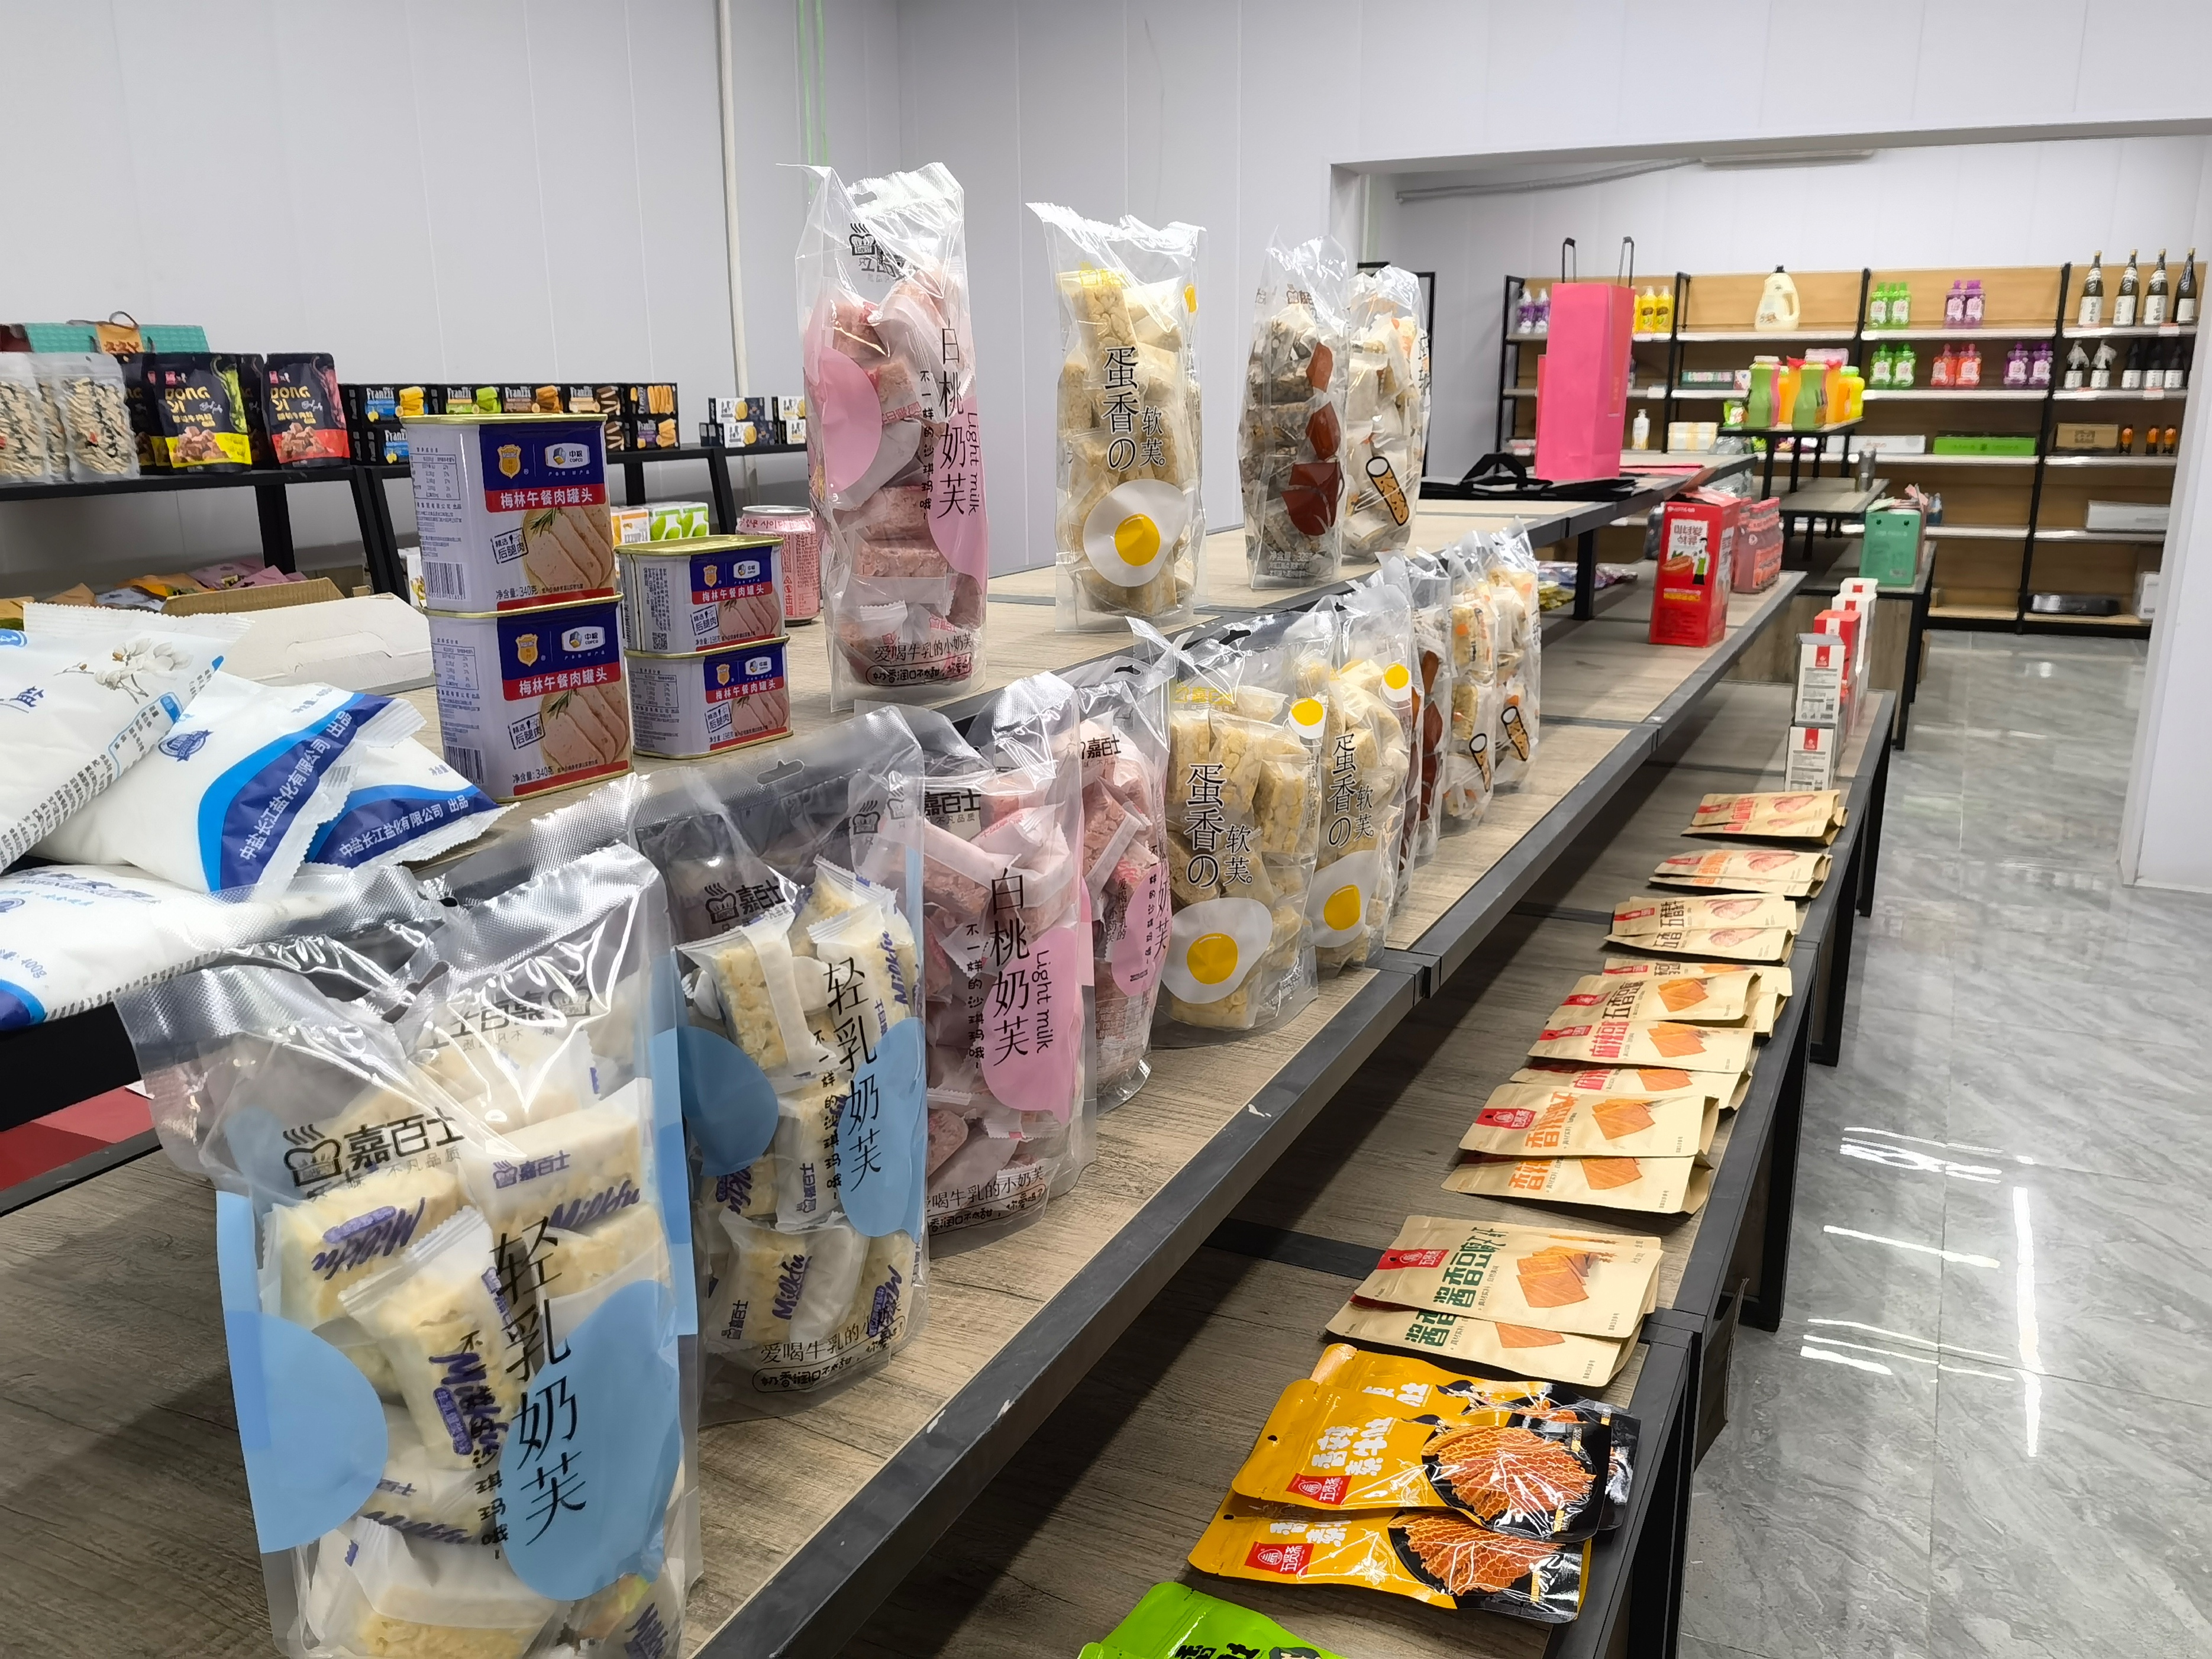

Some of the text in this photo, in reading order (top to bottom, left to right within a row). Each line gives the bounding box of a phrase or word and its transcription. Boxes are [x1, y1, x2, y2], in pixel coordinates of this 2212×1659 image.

[937, 318, 966, 519] 白桃奶芙
[966, 412, 980, 515] Light milk
[500, 488, 593, 509] 梅林午餐肉罐头
[702, 585, 764, 603] 梅林午餐肉罐头
[519, 667, 608, 697] 梅林午餐肉罐头
[715, 679, 776, 700] 梅林午餐肉罐头
[240, 737, 331, 861] 中盐长江盐化有限公司
[326, 710, 353, 738] 出品
[338, 795, 469, 858] 中盐长江盐化有限公司 出品
[1184, 762, 1228, 890] 蛋香の
[989, 867, 1031, 1066] 白桃奶芙
[1031, 950, 1055, 1054] Light milk
[823, 956, 883, 1192] 轻乳奶芙
[489, 1216, 587, 1546] 轻乳奶芙
[1319, 1477, 1342, 1502] 五贤斋
[1280, 1545, 1304, 1573] 五贤斋
